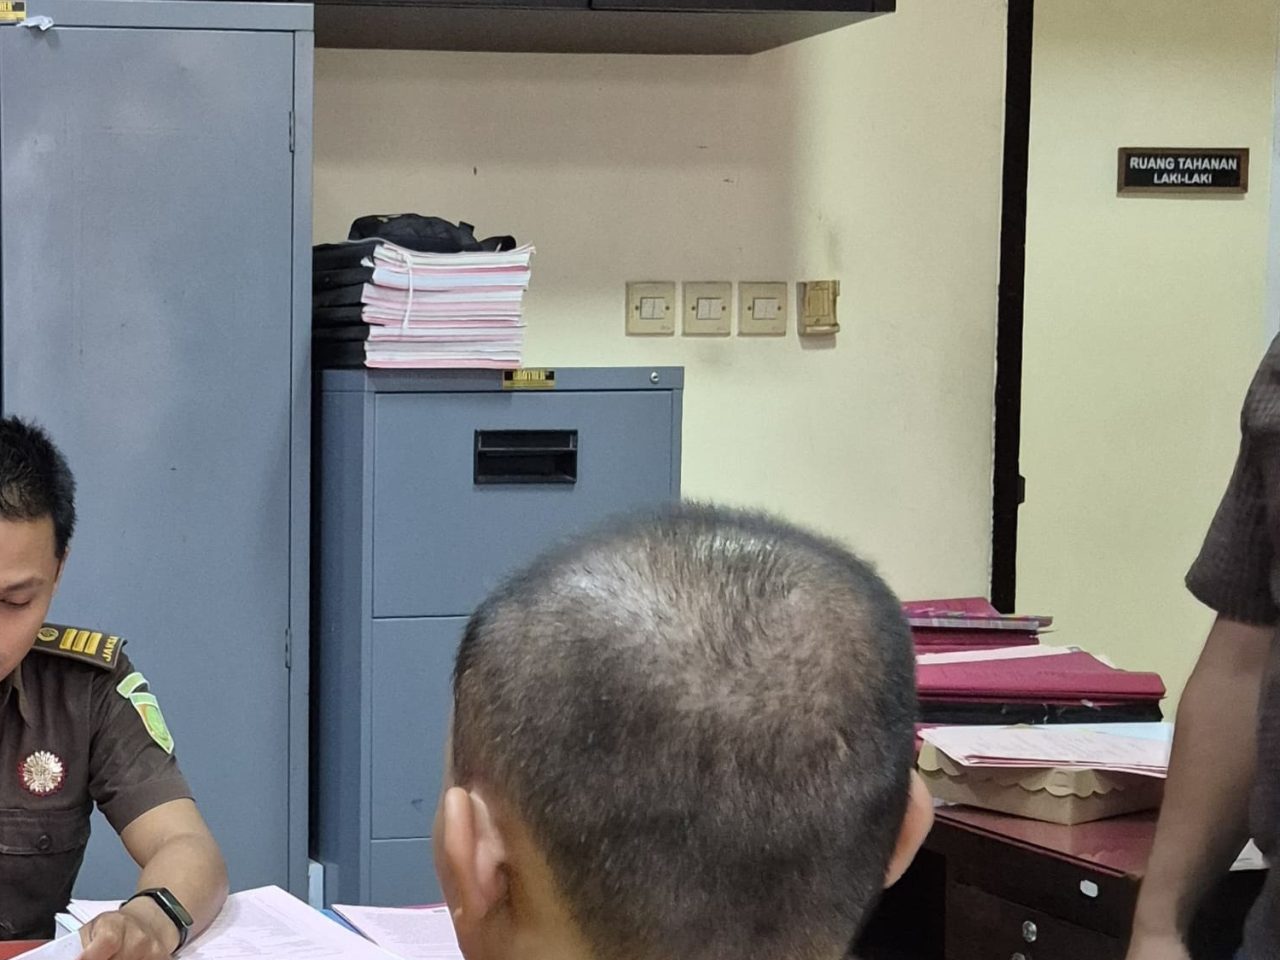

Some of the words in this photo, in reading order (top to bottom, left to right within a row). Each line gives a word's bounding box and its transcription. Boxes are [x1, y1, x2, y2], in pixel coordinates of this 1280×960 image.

[1129, 156, 1174, 169] RUANG
[1178, 157, 1237, 171] TAHANAN
[1153, 173, 1212, 185] LAKI-LAKI
